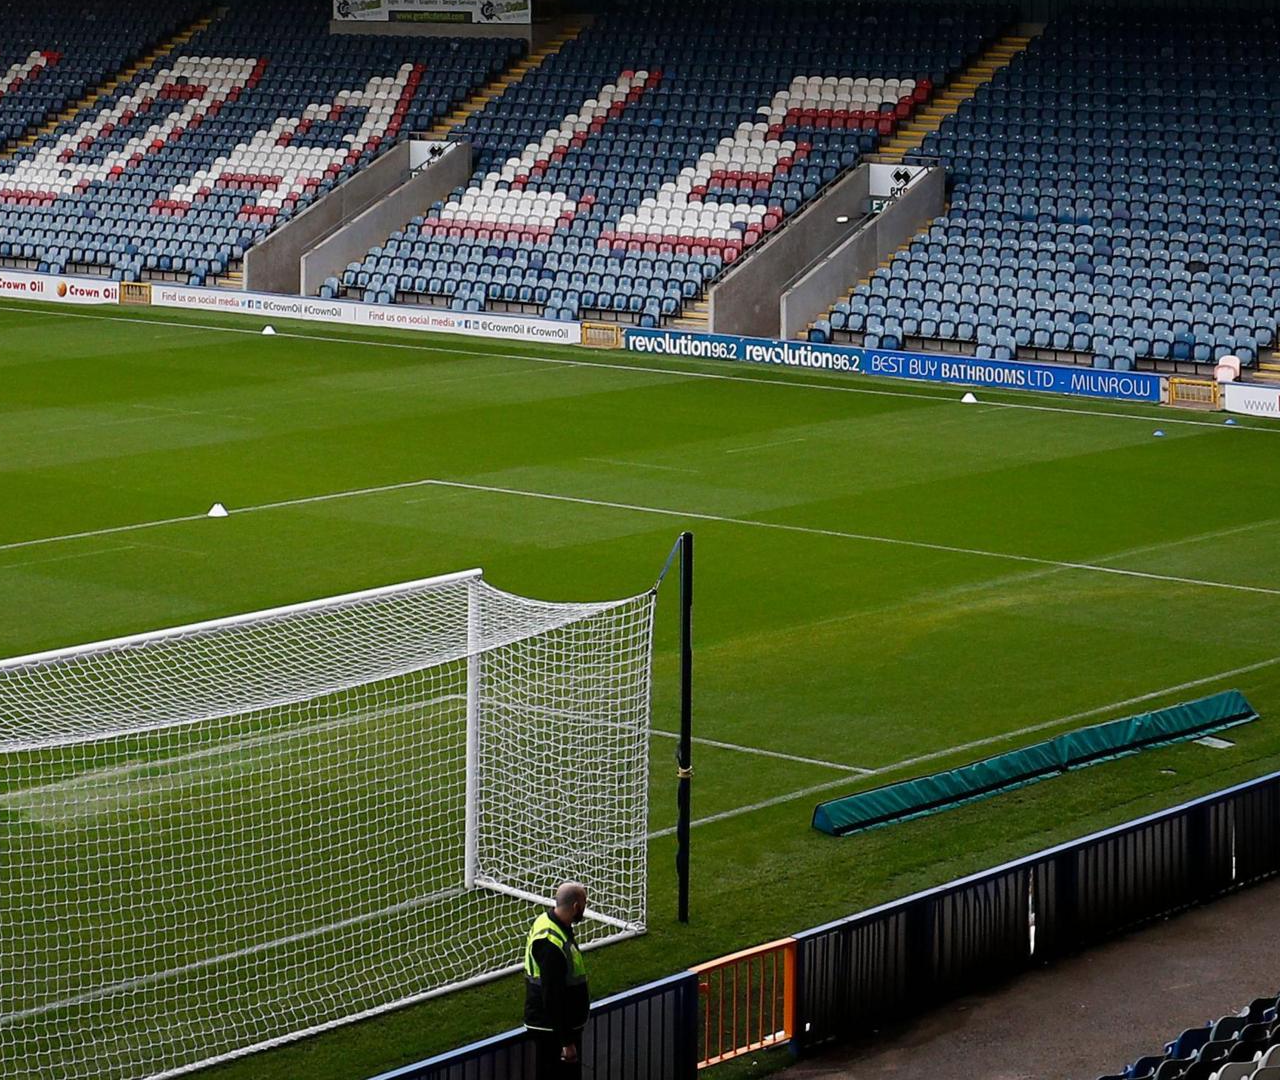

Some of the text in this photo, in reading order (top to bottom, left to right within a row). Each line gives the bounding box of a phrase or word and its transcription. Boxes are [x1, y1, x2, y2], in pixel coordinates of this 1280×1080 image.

[29, 278, 44, 293] Oil
[67, 284, 118, 301] Crown Oil
[161, 291, 342, 318] Find us on social media @CrownOil #CrownOil
[368, 310, 569, 339] Find us on social media @CrownOil #CrownOil
[628, 332, 737, 360] revolution96.2
[745, 343, 860, 372] revolution96.2
[870, 355, 906, 374] BEST
[908, 359, 938, 377] BUY
[941, 363, 1026, 386] BATHROOMS
[1027, 370, 1055, 389] LTD
[1070, 373, 1151, 399] MILNROW
